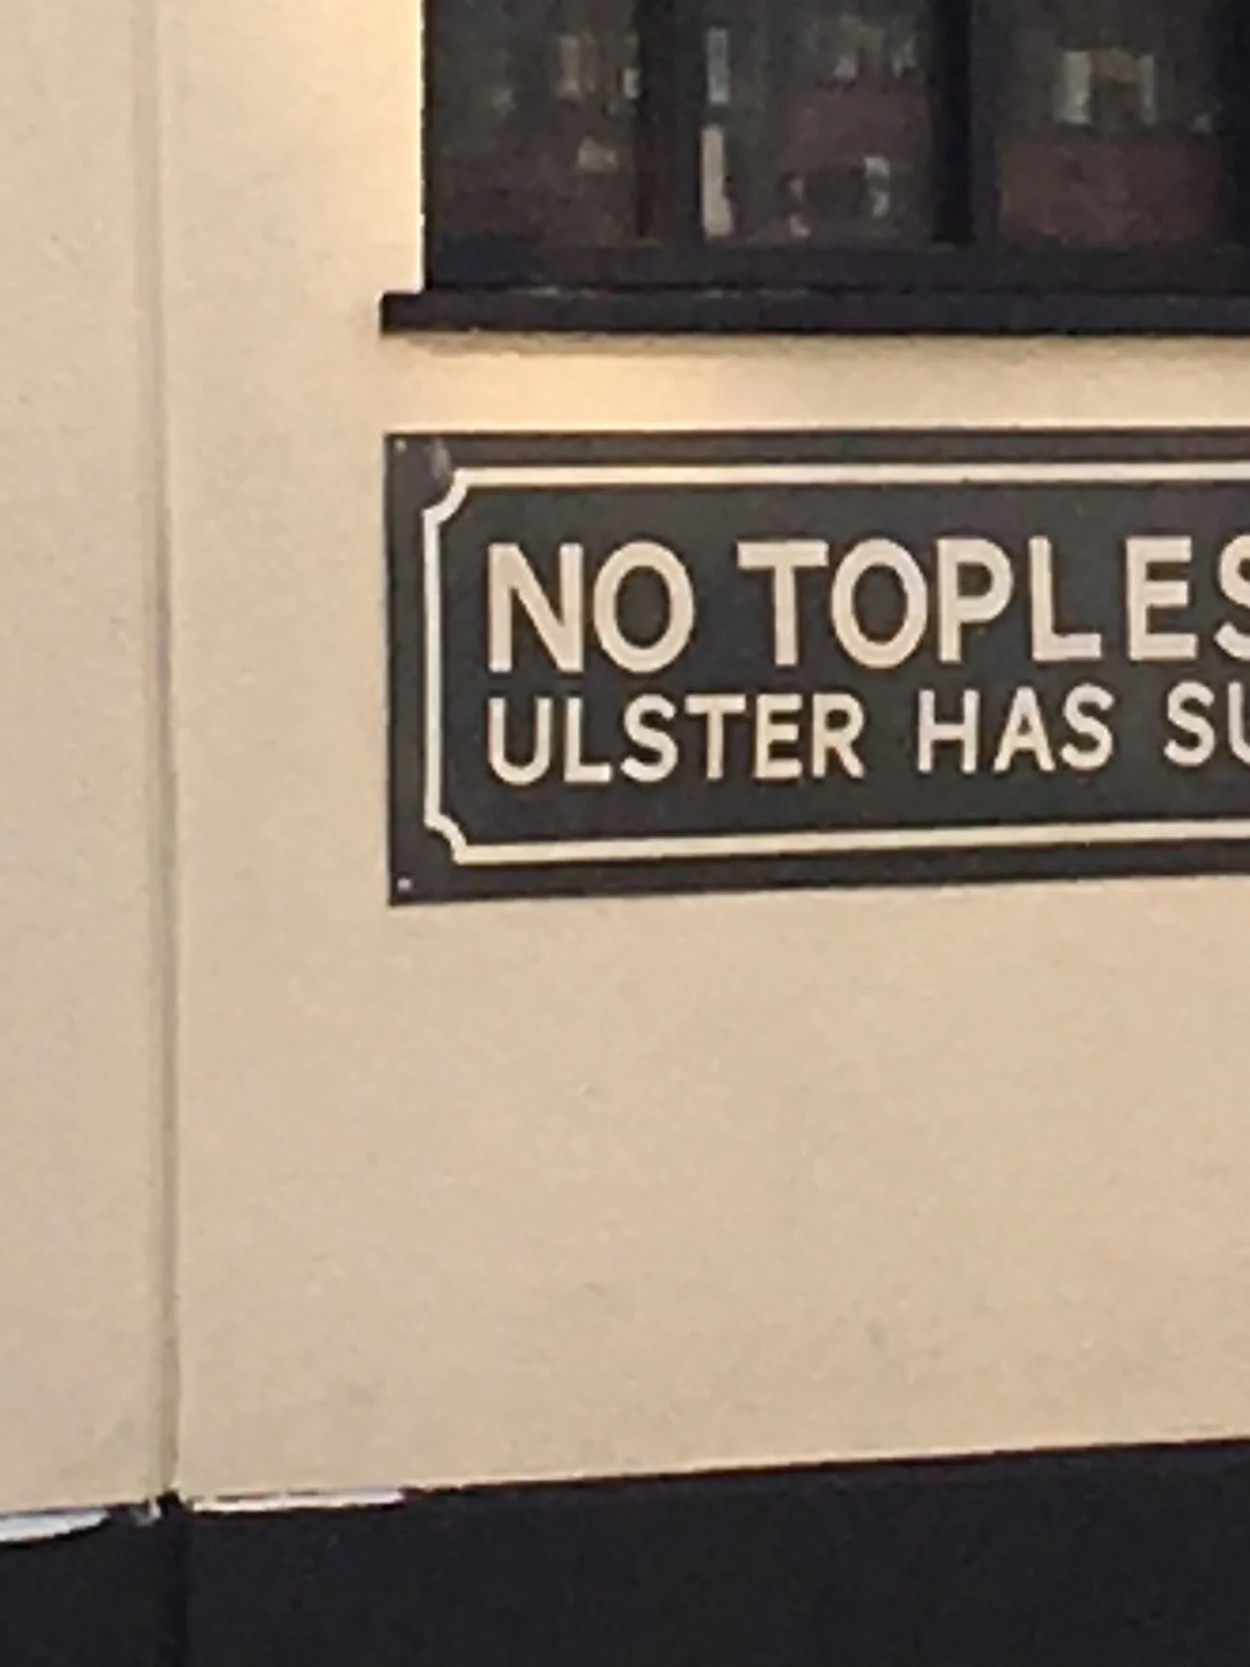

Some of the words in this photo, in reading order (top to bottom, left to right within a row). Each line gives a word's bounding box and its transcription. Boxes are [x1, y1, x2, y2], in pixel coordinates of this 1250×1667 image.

[487, 540, 695, 674] NO
[487, 692, 865, 786] ULSTER
[917, 682, 1115, 774] HAS
